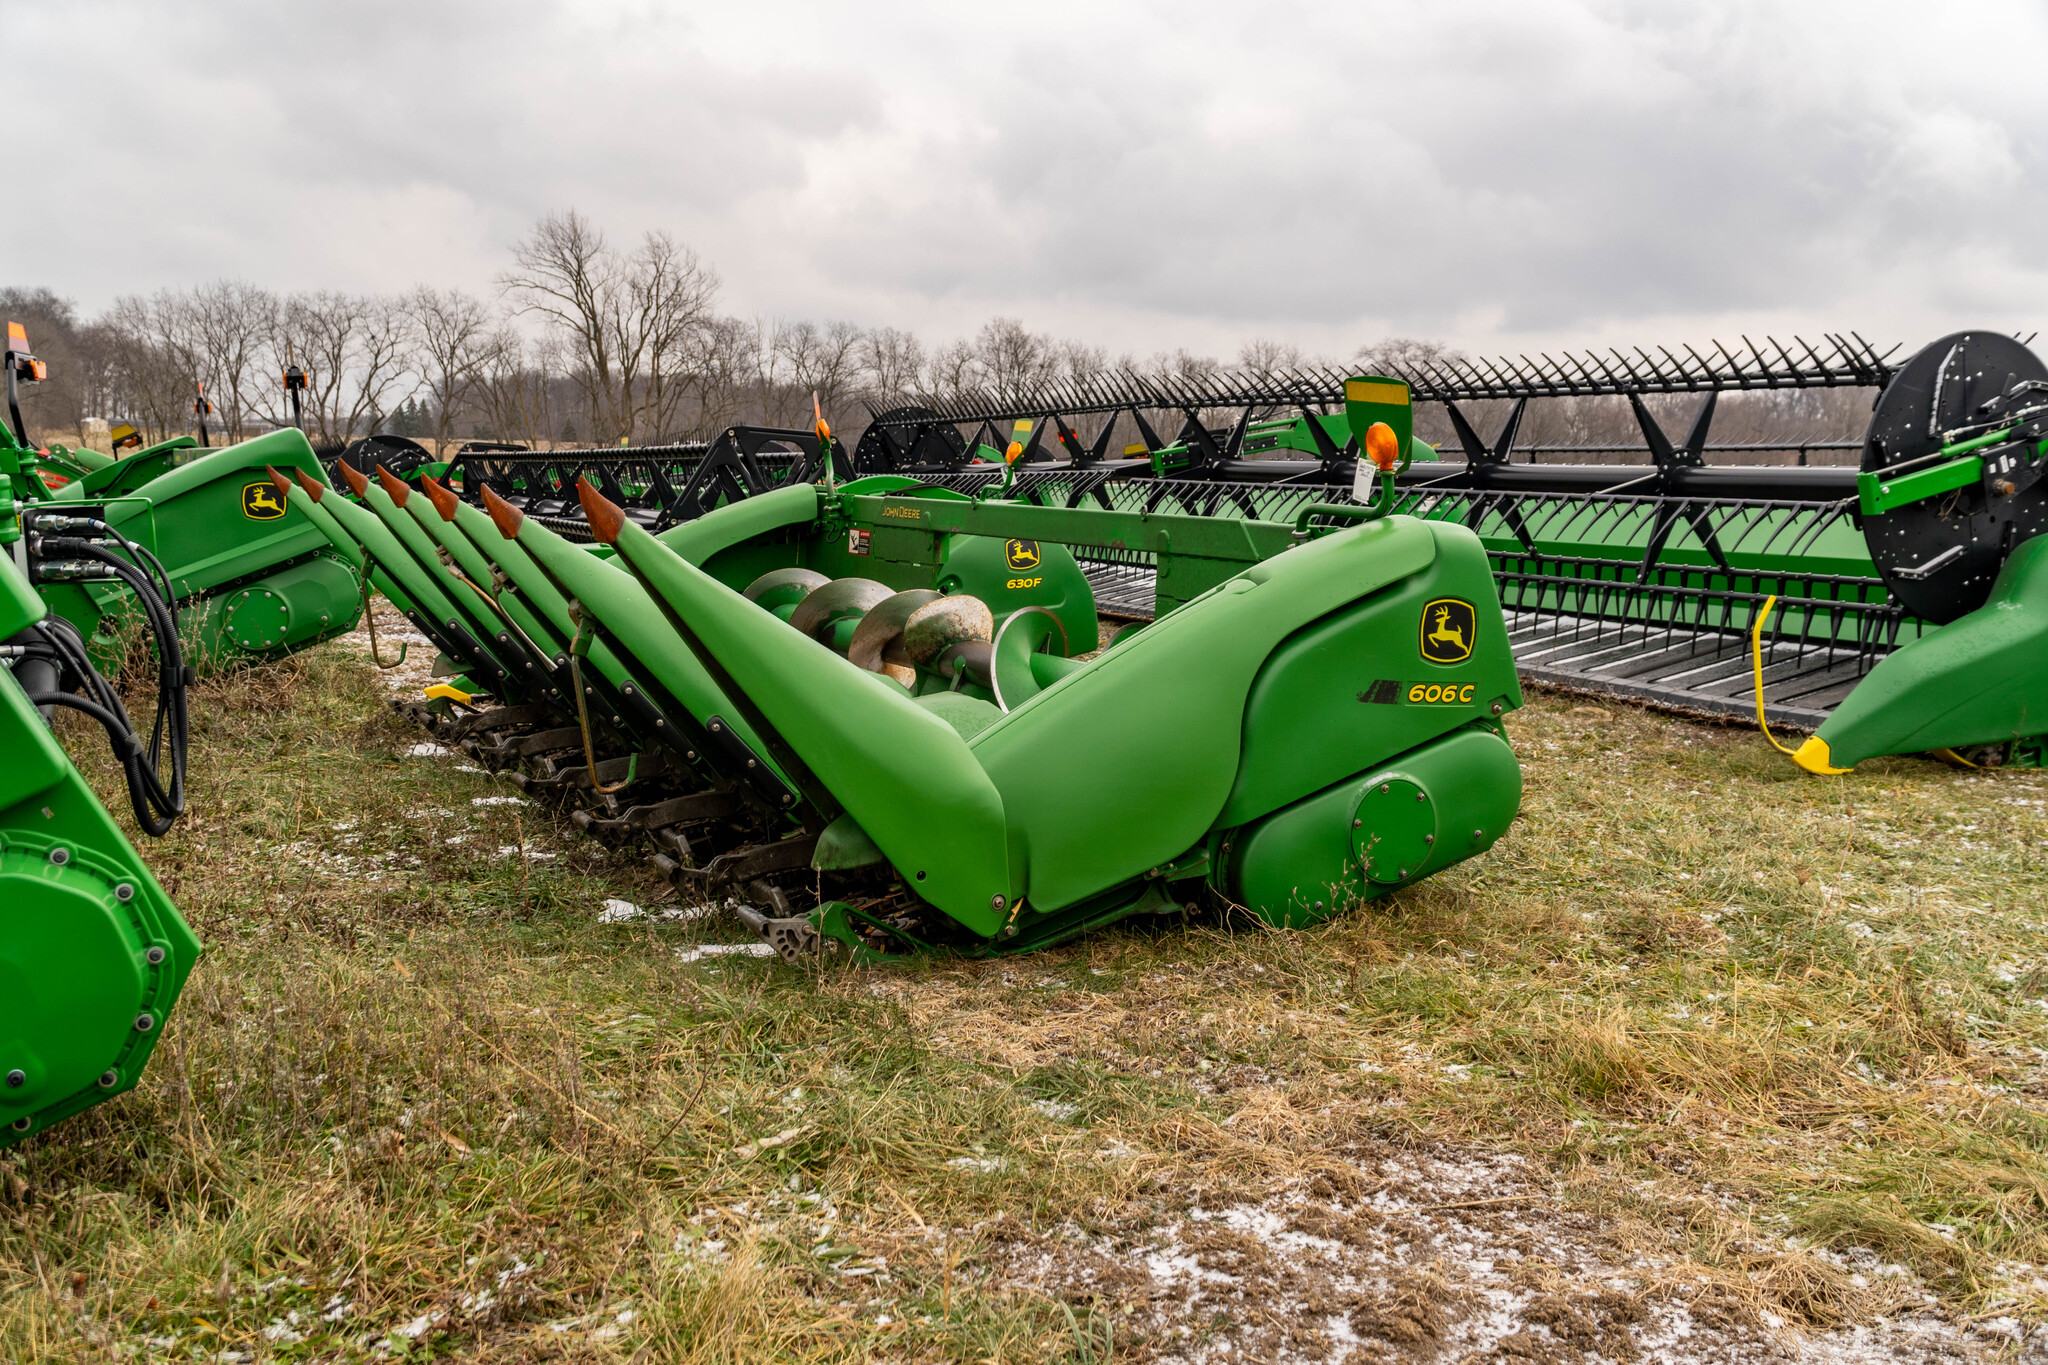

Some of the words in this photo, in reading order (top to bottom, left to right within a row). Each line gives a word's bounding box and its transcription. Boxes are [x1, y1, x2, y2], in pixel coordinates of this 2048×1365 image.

[882, 505, 899, 518] JOHN
[900, 506, 920, 519] DEERE
[1006, 577, 1042, 589] 630F
[1408, 684, 1475, 703] 606C
